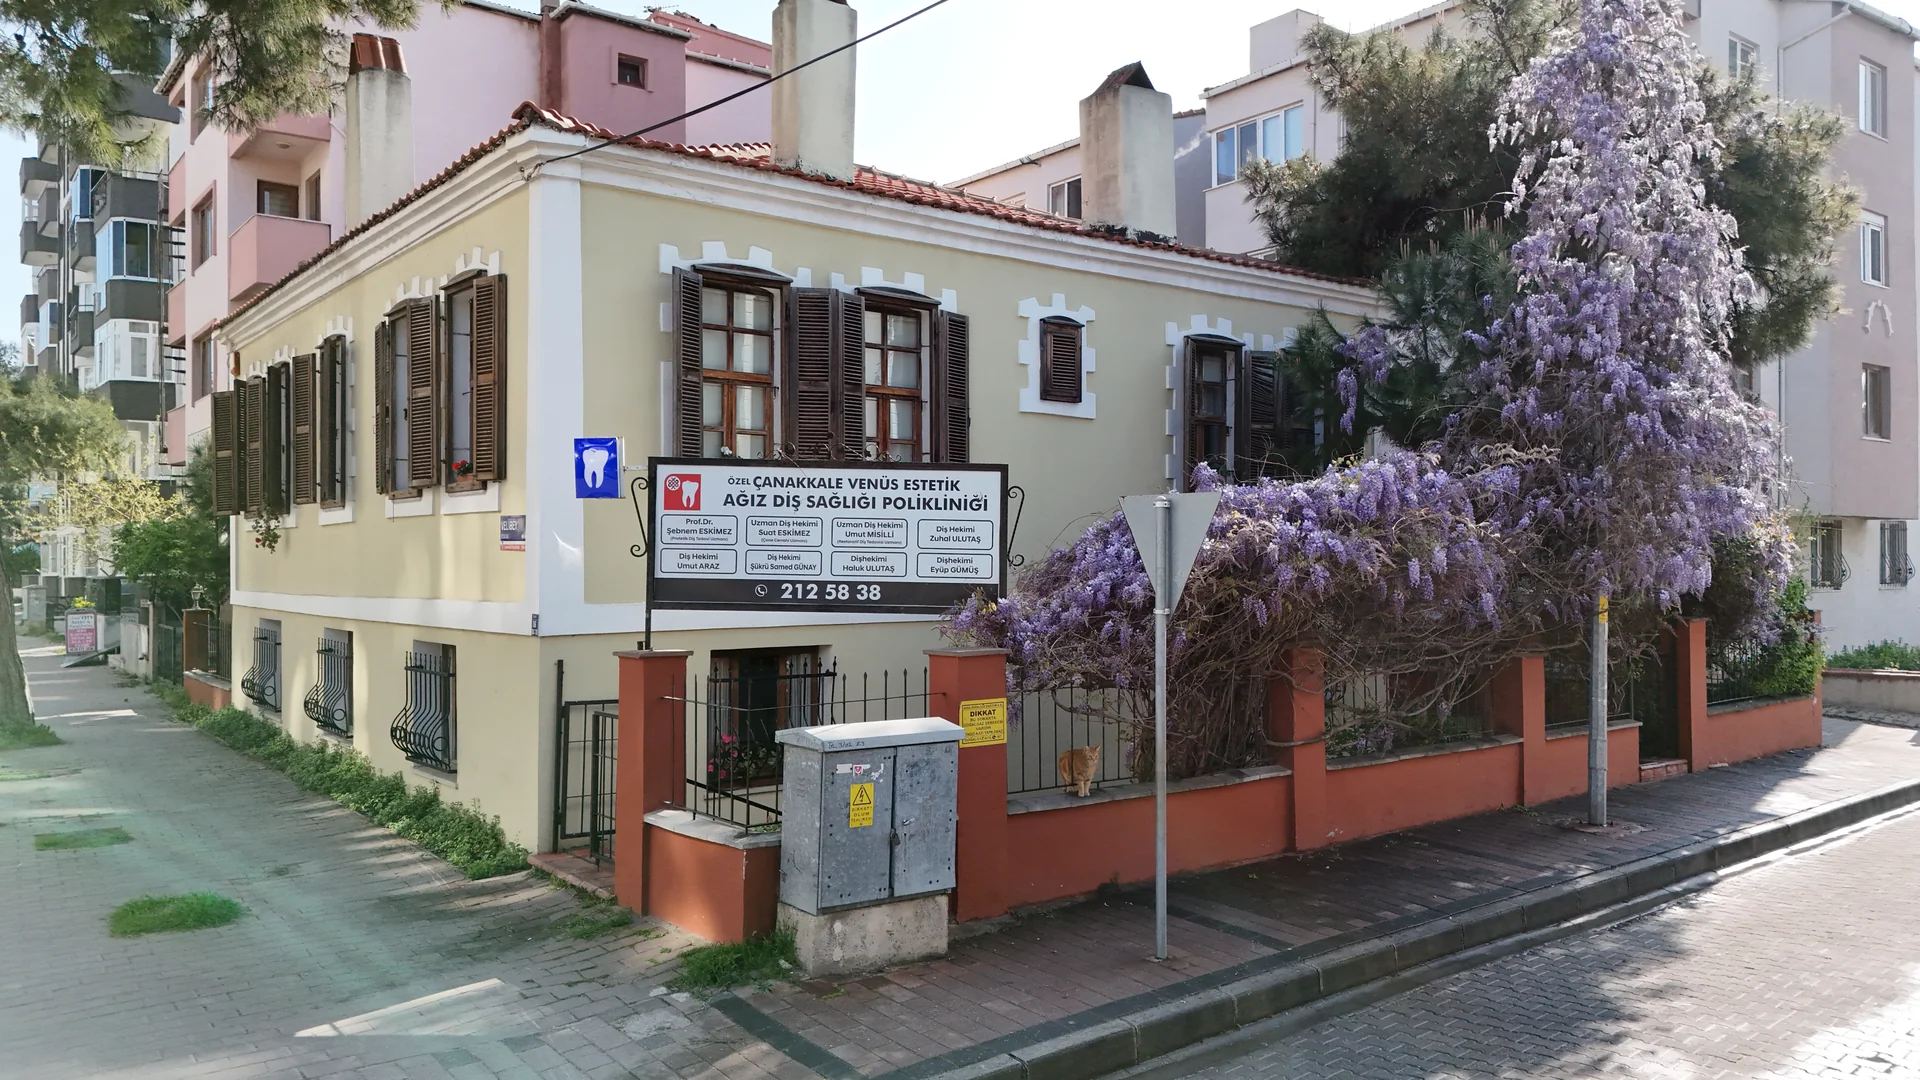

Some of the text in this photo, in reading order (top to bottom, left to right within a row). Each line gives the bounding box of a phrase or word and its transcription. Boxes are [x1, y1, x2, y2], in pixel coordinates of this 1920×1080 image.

[728, 475, 960, 492] ÖZEL ÇANAKKALE VENÜS ESTETİK
[723, 490, 988, 511] AĞIZ DİŞ SAĞLIĞI POLİKLİNİĞİ
[779, 520, 791, 528] Diş
[864, 521, 876, 529] Diş
[666, 527, 732, 535] Şebnem ESKİMEZ
[778, 528, 811, 537] ESKİMEZ
[936, 525, 975, 533] Diş Hekimi
[867, 530, 894, 538] MİSİLLİ
[850, 555, 887, 563] Dişhekimi
[936, 557, 973, 565] Dişhekimi
[750, 563, 769, 571] Şükrü
[794, 563, 817, 571] GÜNAY
[865, 565, 895, 573] ULUTAŞ
[930, 566, 979, 575] Eyüp GÜMÜŞ
[781, 583, 881, 601] 212 58 38
